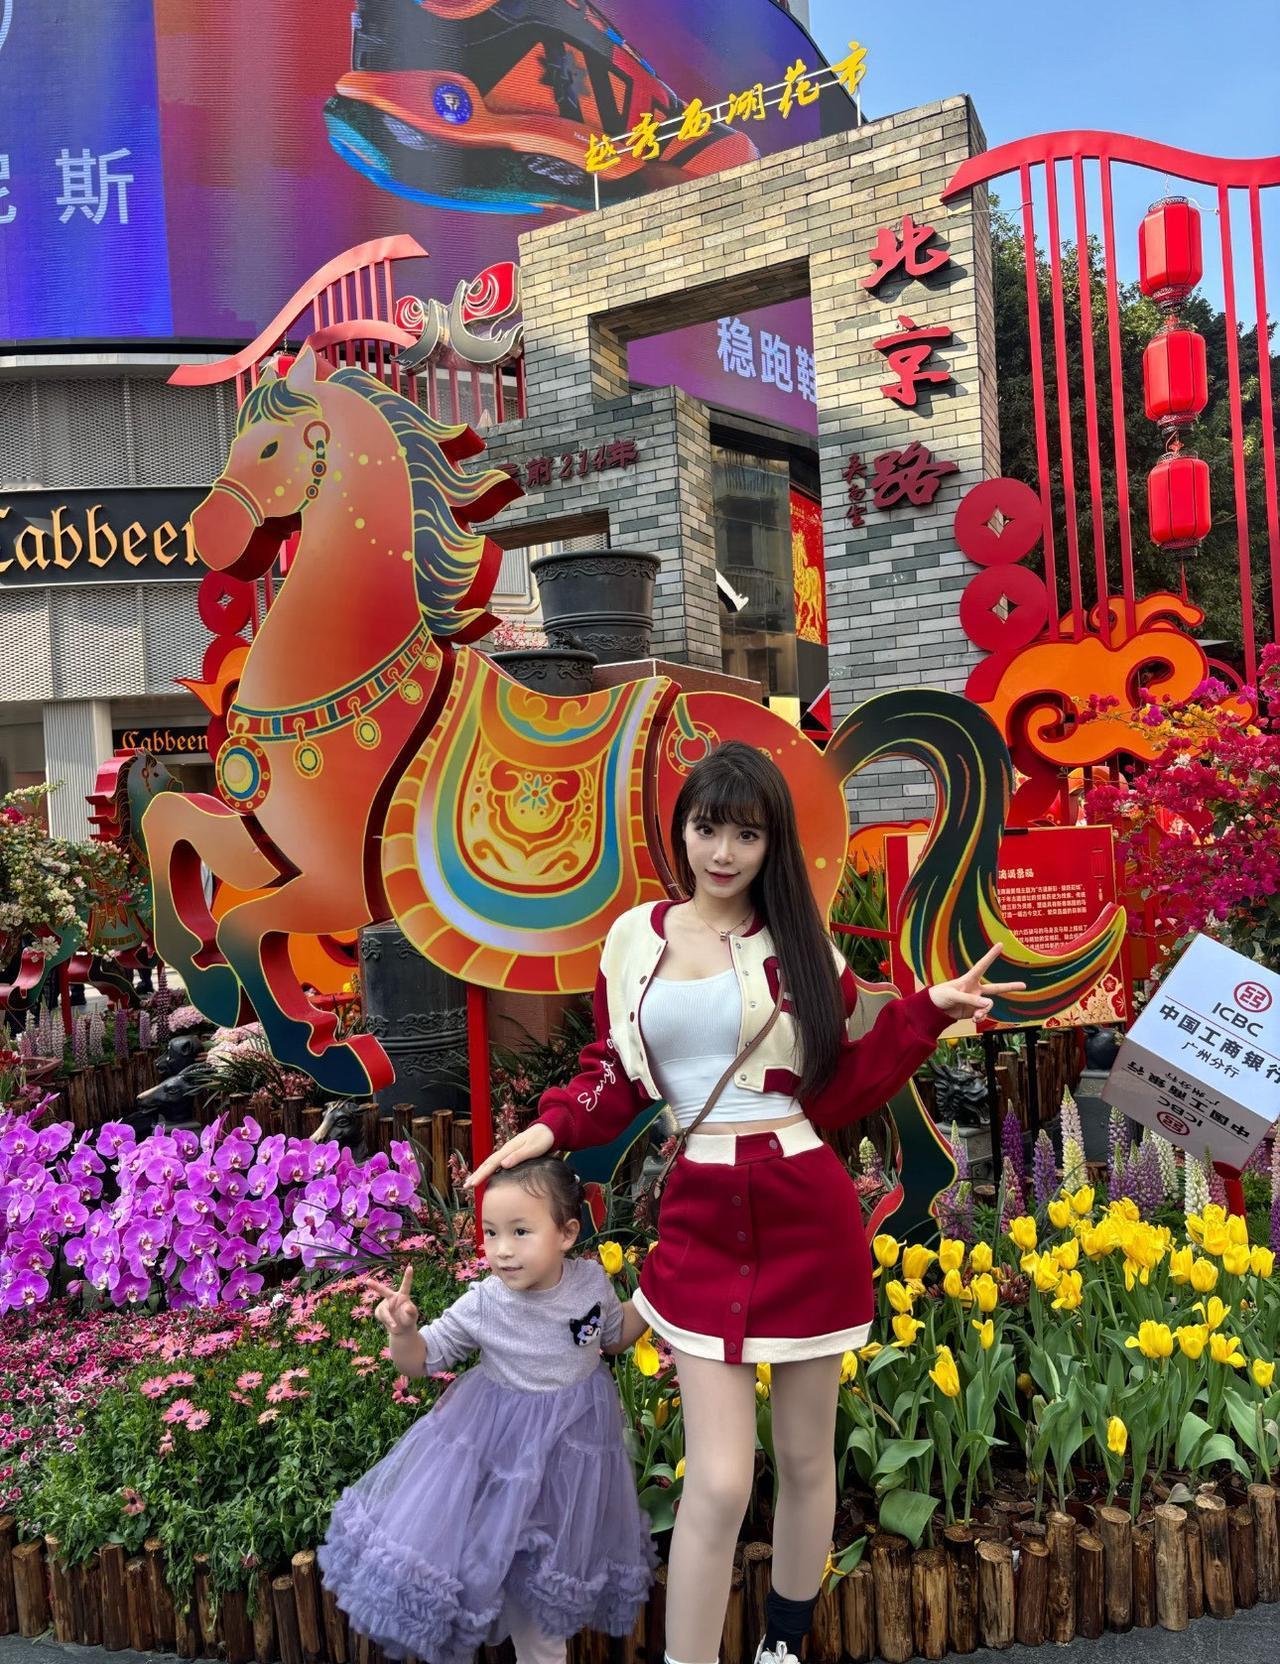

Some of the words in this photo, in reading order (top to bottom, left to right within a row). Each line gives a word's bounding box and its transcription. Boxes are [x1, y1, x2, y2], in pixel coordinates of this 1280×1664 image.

[0, 147, 134, 225] 斯
[858, 213, 960, 511] 北京路
[1211, 1002, 1264, 1038] ICBC
[1181, 1041, 1240, 1078] 广州分行
[1127, 1061, 1250, 1139] 中国工商银行
[1157, 1096, 1203, 1127] ICBC
